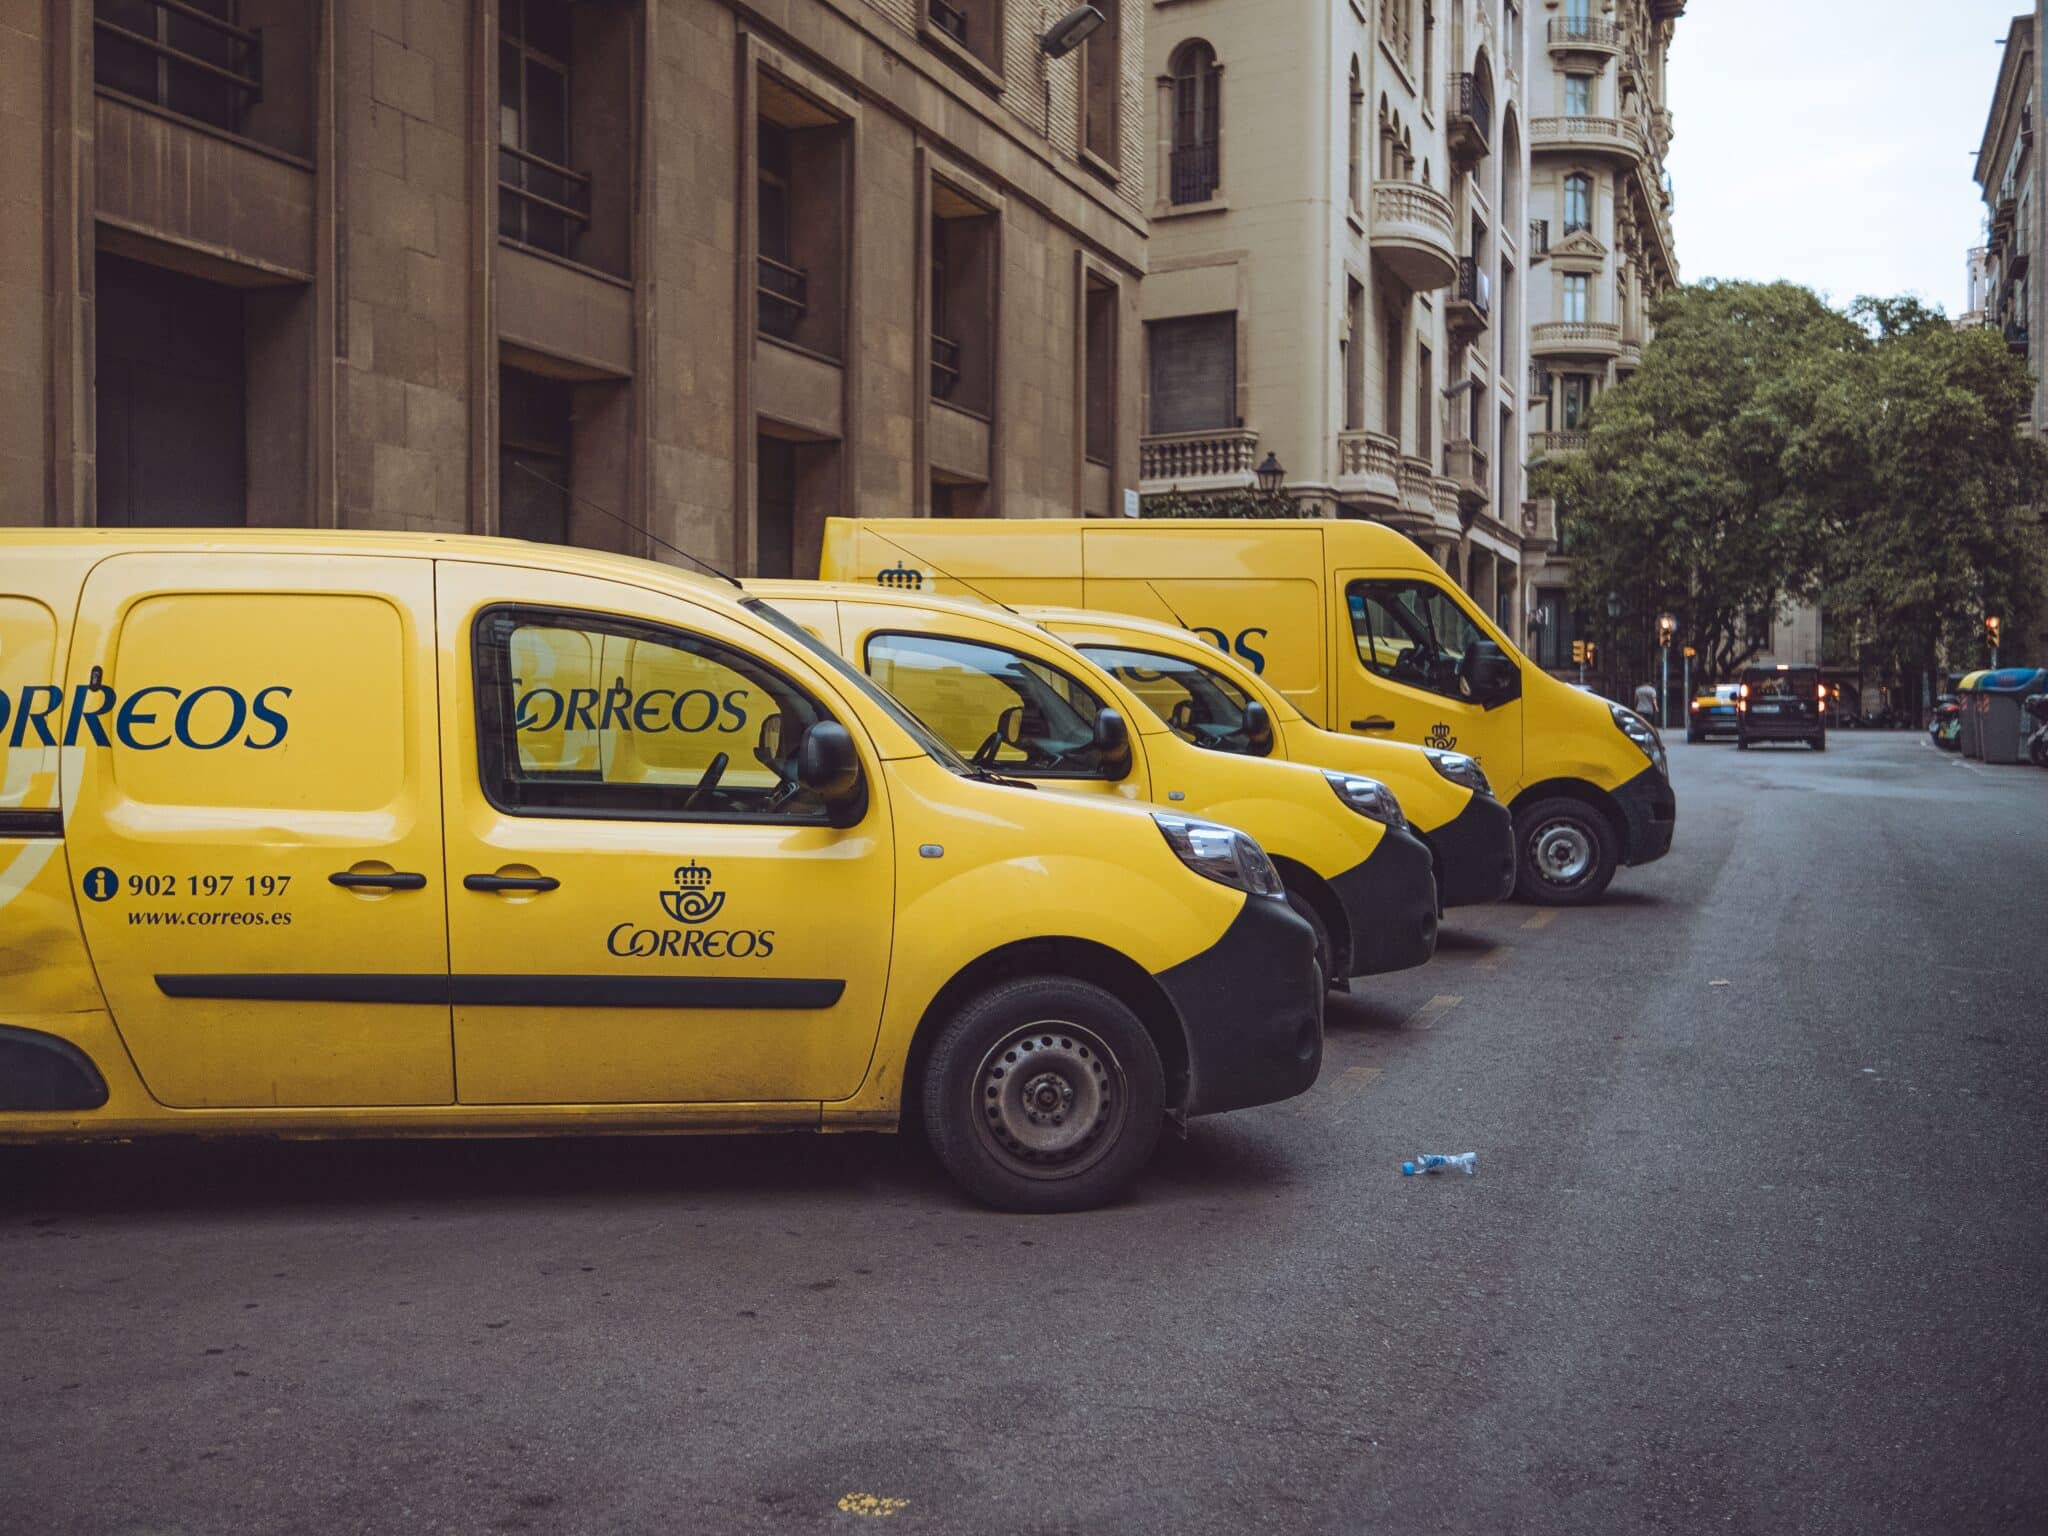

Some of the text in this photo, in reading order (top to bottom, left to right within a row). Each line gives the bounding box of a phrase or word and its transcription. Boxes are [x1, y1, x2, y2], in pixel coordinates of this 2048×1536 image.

[0, 686, 293, 750] RREOS
[128, 875, 176, 897] 902
[188, 875, 234, 897] 197
[246, 875, 292, 897] 197
[128, 908, 292, 926] www.correos.es
[607, 923, 775, 958] CORREOS
